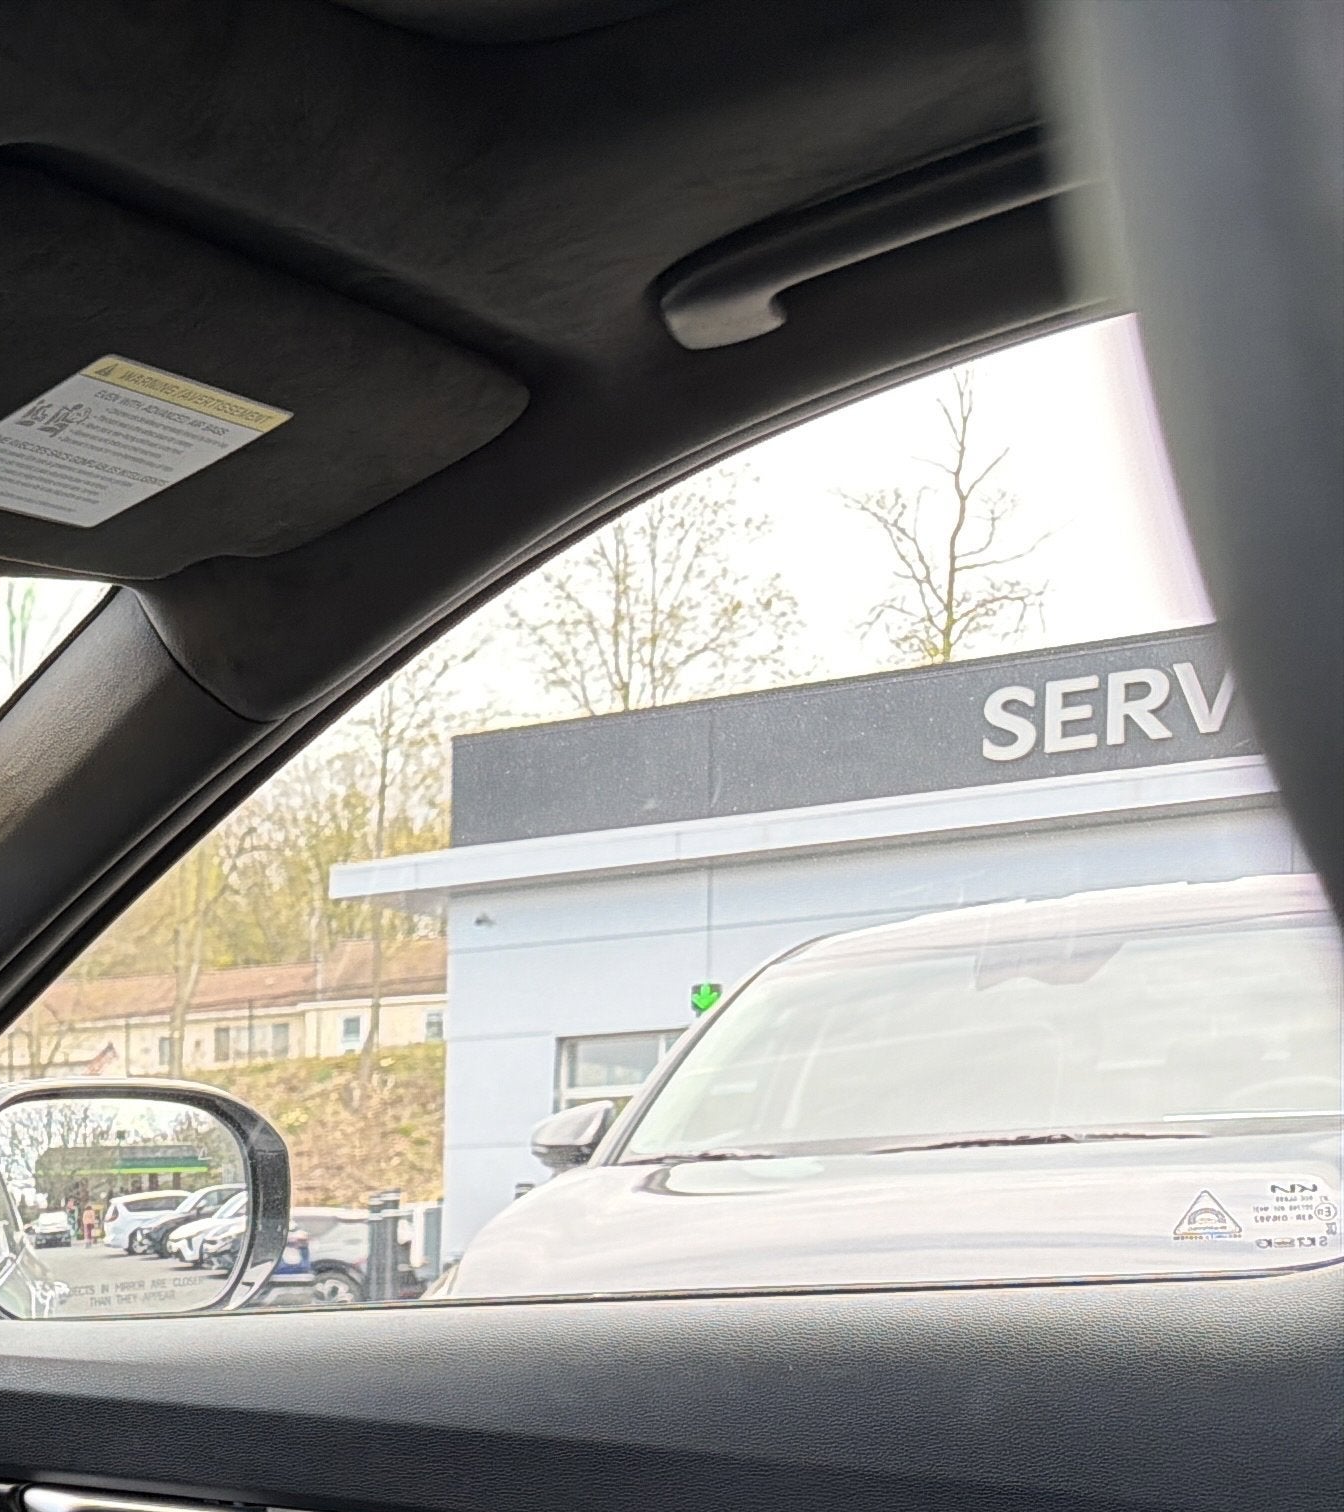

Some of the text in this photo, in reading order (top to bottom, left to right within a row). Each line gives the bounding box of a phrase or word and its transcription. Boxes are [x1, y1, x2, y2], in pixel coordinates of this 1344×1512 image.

[120, 370, 178, 397] WARNING
[982, 662, 1237, 762] SERV
[150, 1278, 166, 1289] ARE
